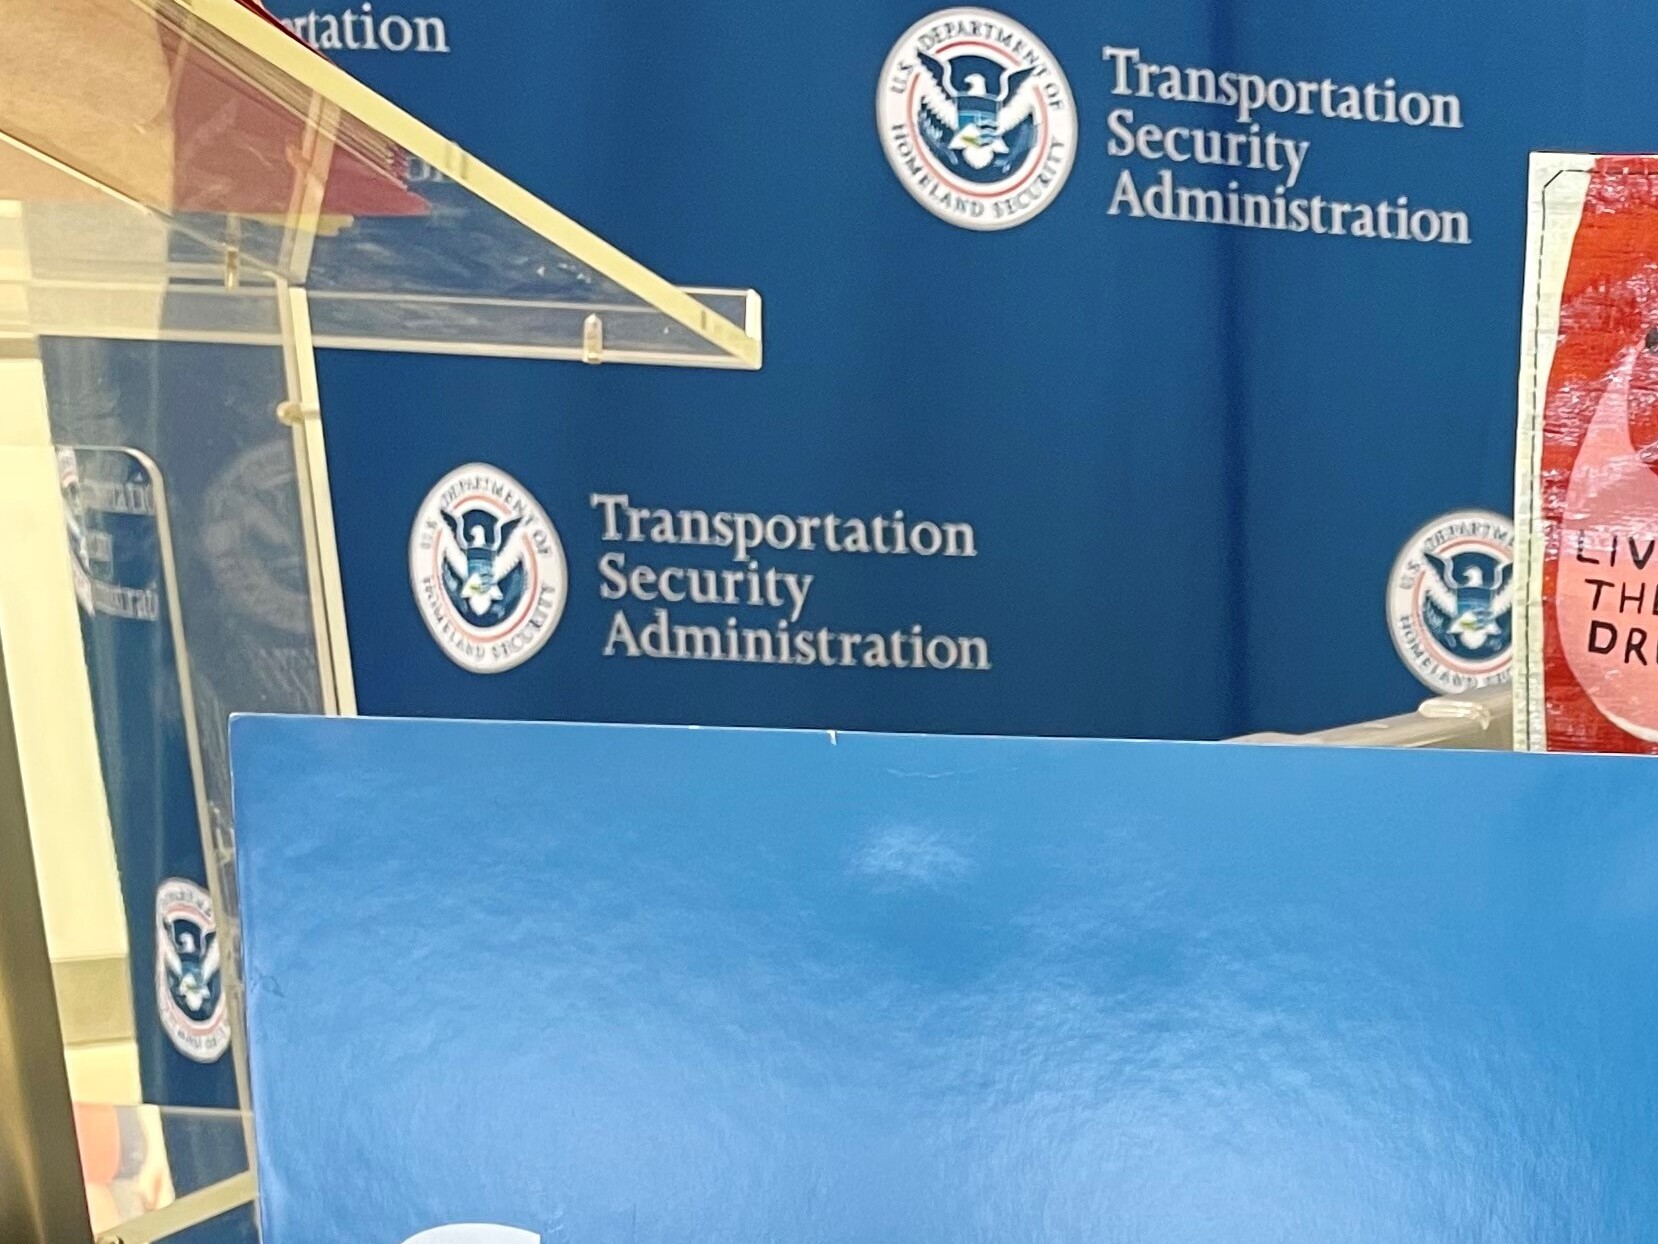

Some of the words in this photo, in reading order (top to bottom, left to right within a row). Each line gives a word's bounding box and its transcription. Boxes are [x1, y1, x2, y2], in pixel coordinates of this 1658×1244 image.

[917, 20, 1050, 77] DEPARTMENT
[1044, 82, 1064, 111] OF
[1102, 46, 1463, 128] Transportation
[891, 123, 985, 218] HOMELAND
[992, 137, 1065, 219] SECURITY
[1107, 108, 1310, 188] Security
[1106, 169, 1472, 244] Administration
[590, 493, 978, 561] Transportation
[600, 553, 814, 621] Security
[603, 608, 992, 670] Administration
